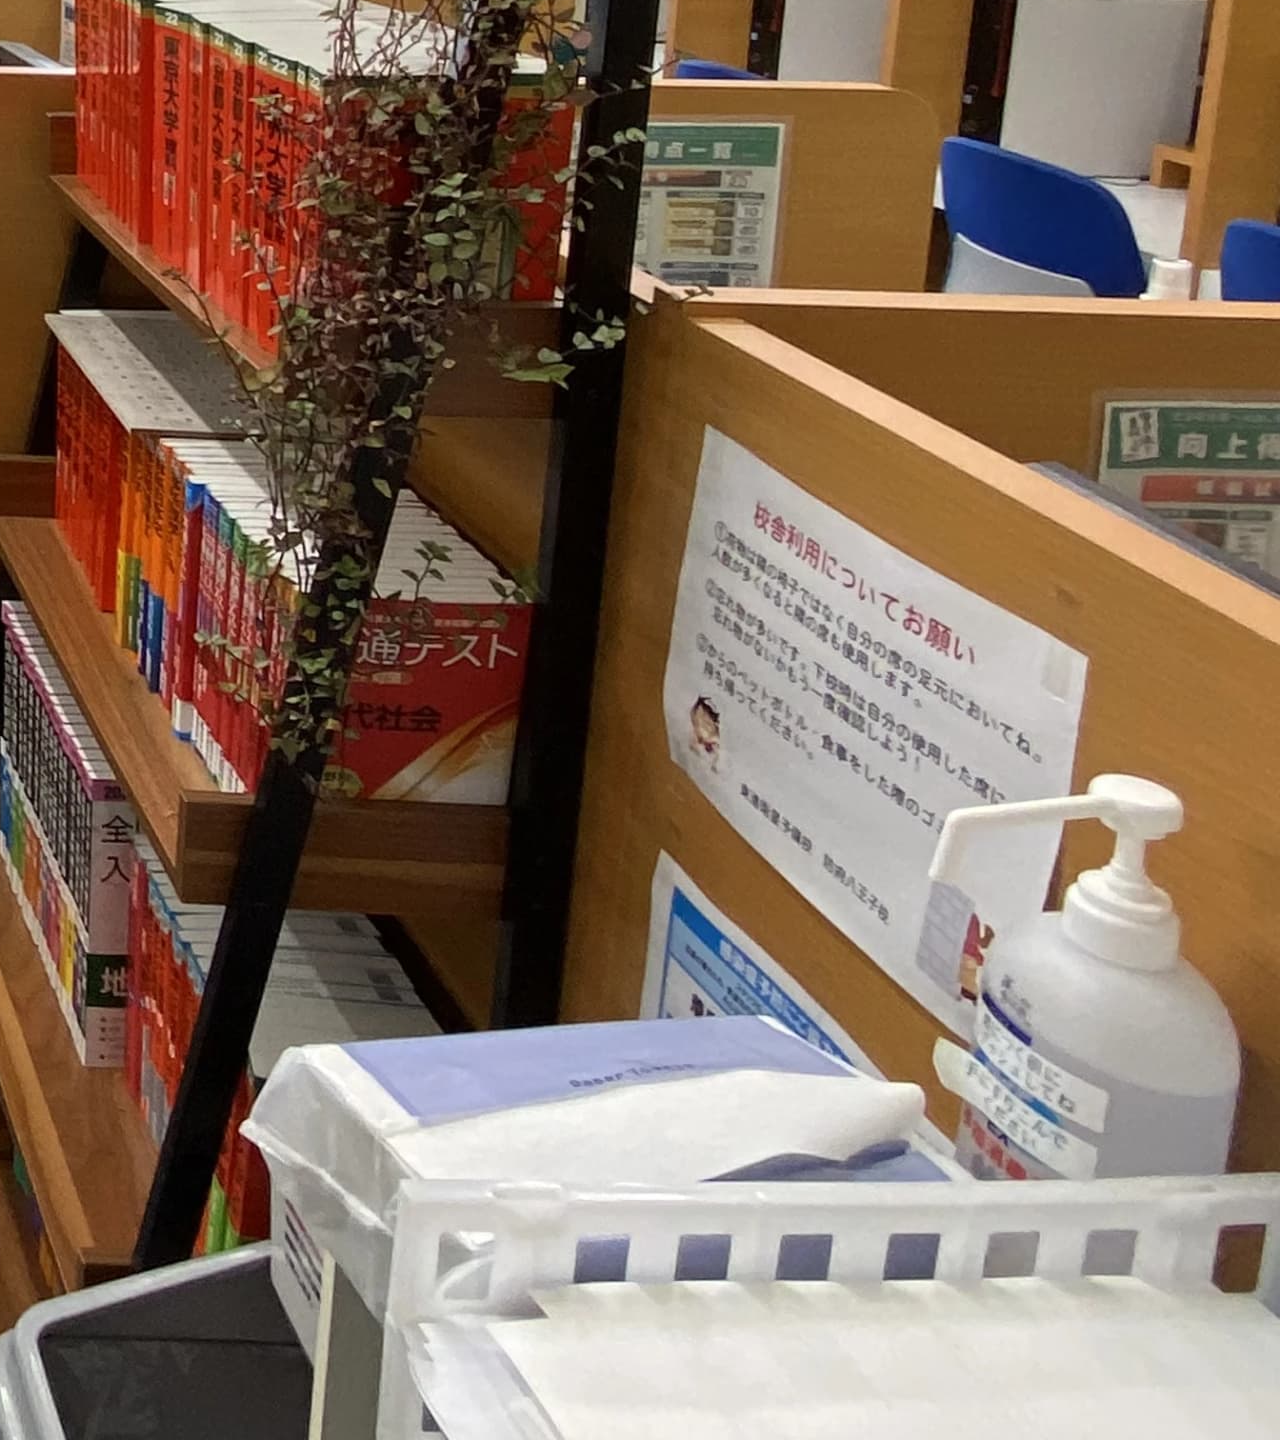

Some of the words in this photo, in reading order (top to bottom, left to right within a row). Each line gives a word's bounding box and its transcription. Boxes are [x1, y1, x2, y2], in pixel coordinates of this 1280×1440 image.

[162, 35, 180, 133] 東京大学
[754, 500, 977, 666] 校舎利用についてお願い
[354, 627, 518, 670] 通テスト
[343, 702, 443, 733] 代社会
